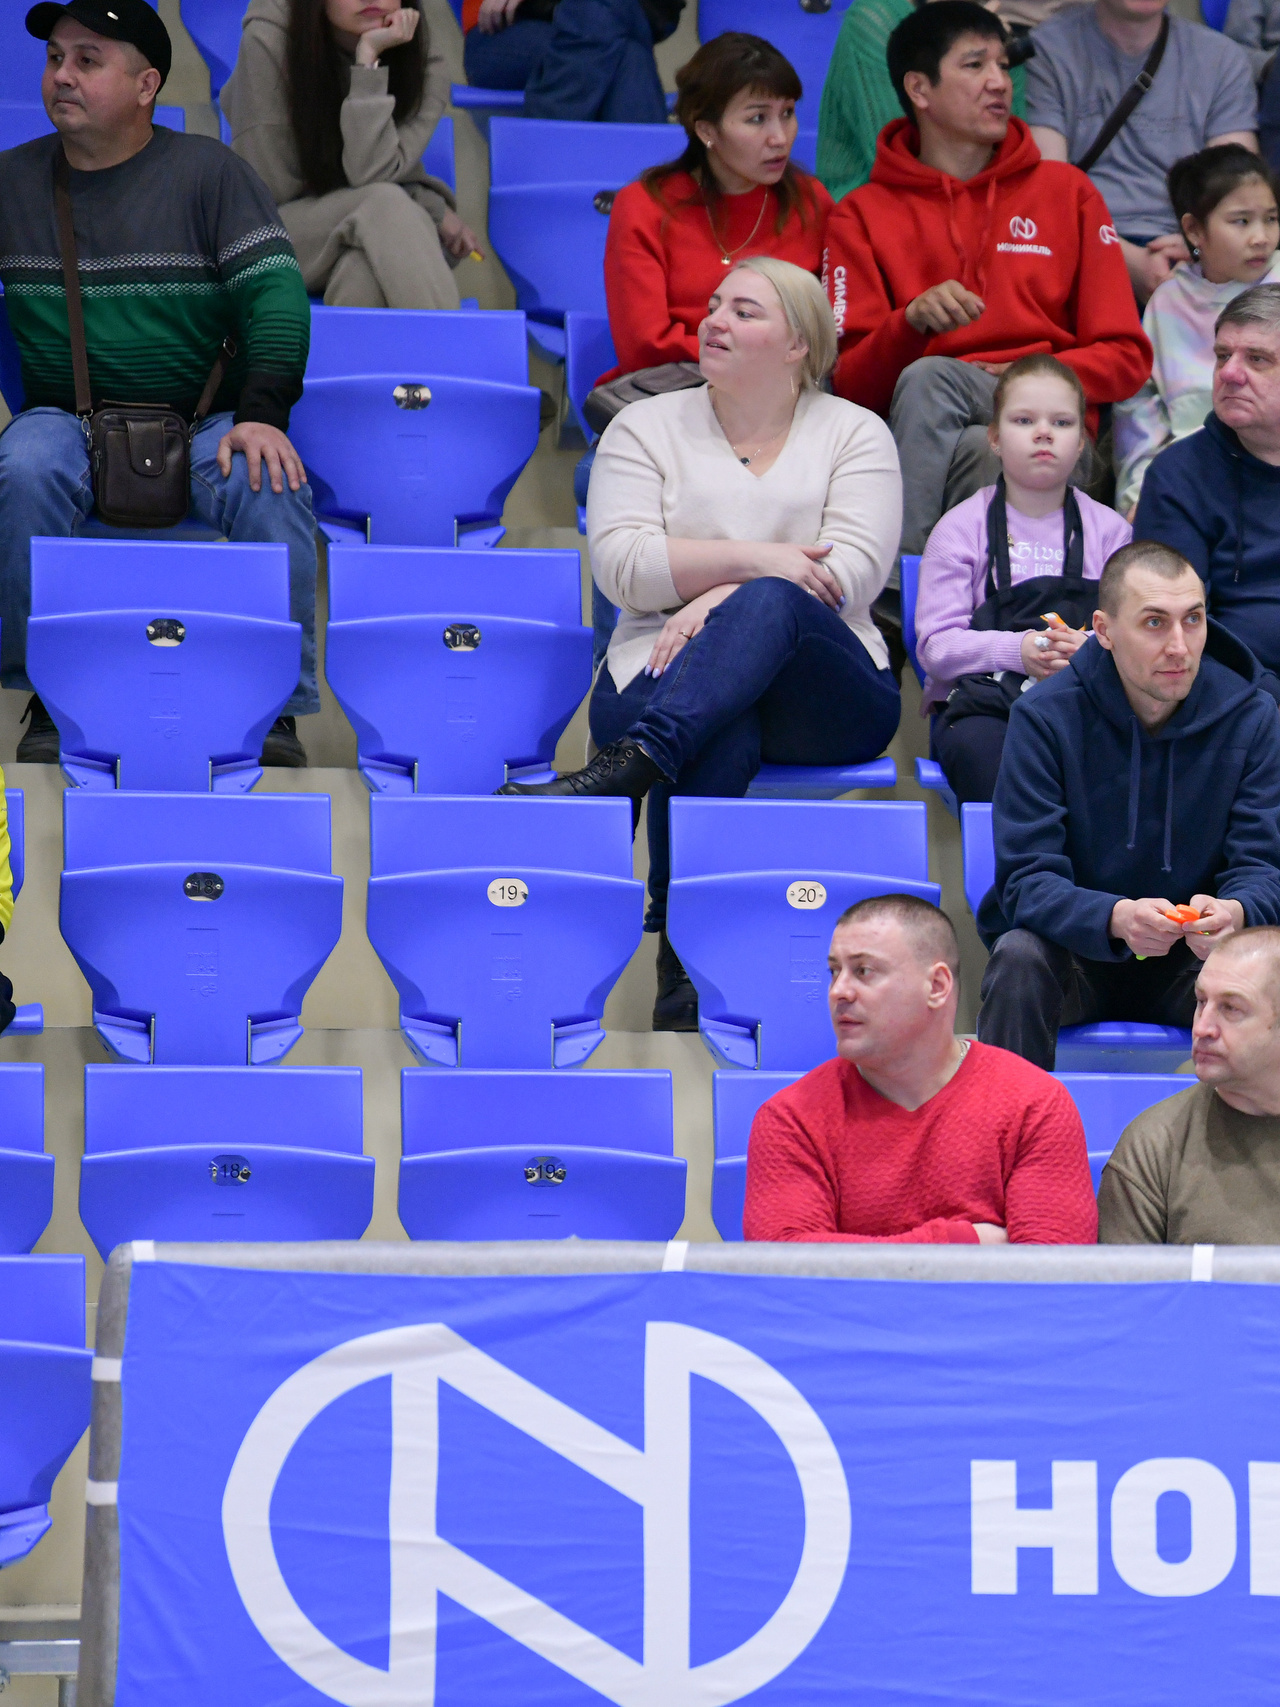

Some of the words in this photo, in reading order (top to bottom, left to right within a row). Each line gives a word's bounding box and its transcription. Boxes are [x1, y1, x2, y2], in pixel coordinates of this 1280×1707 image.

[156, 625, 174, 640] 18
[453, 630, 472, 645] 19
[194, 879, 213, 895] 18
[498, 885, 518, 900] 19
[797, 888, 817, 903] 20
[220, 1163, 240, 1178] 18
[536, 1163, 556, 1179] 19
